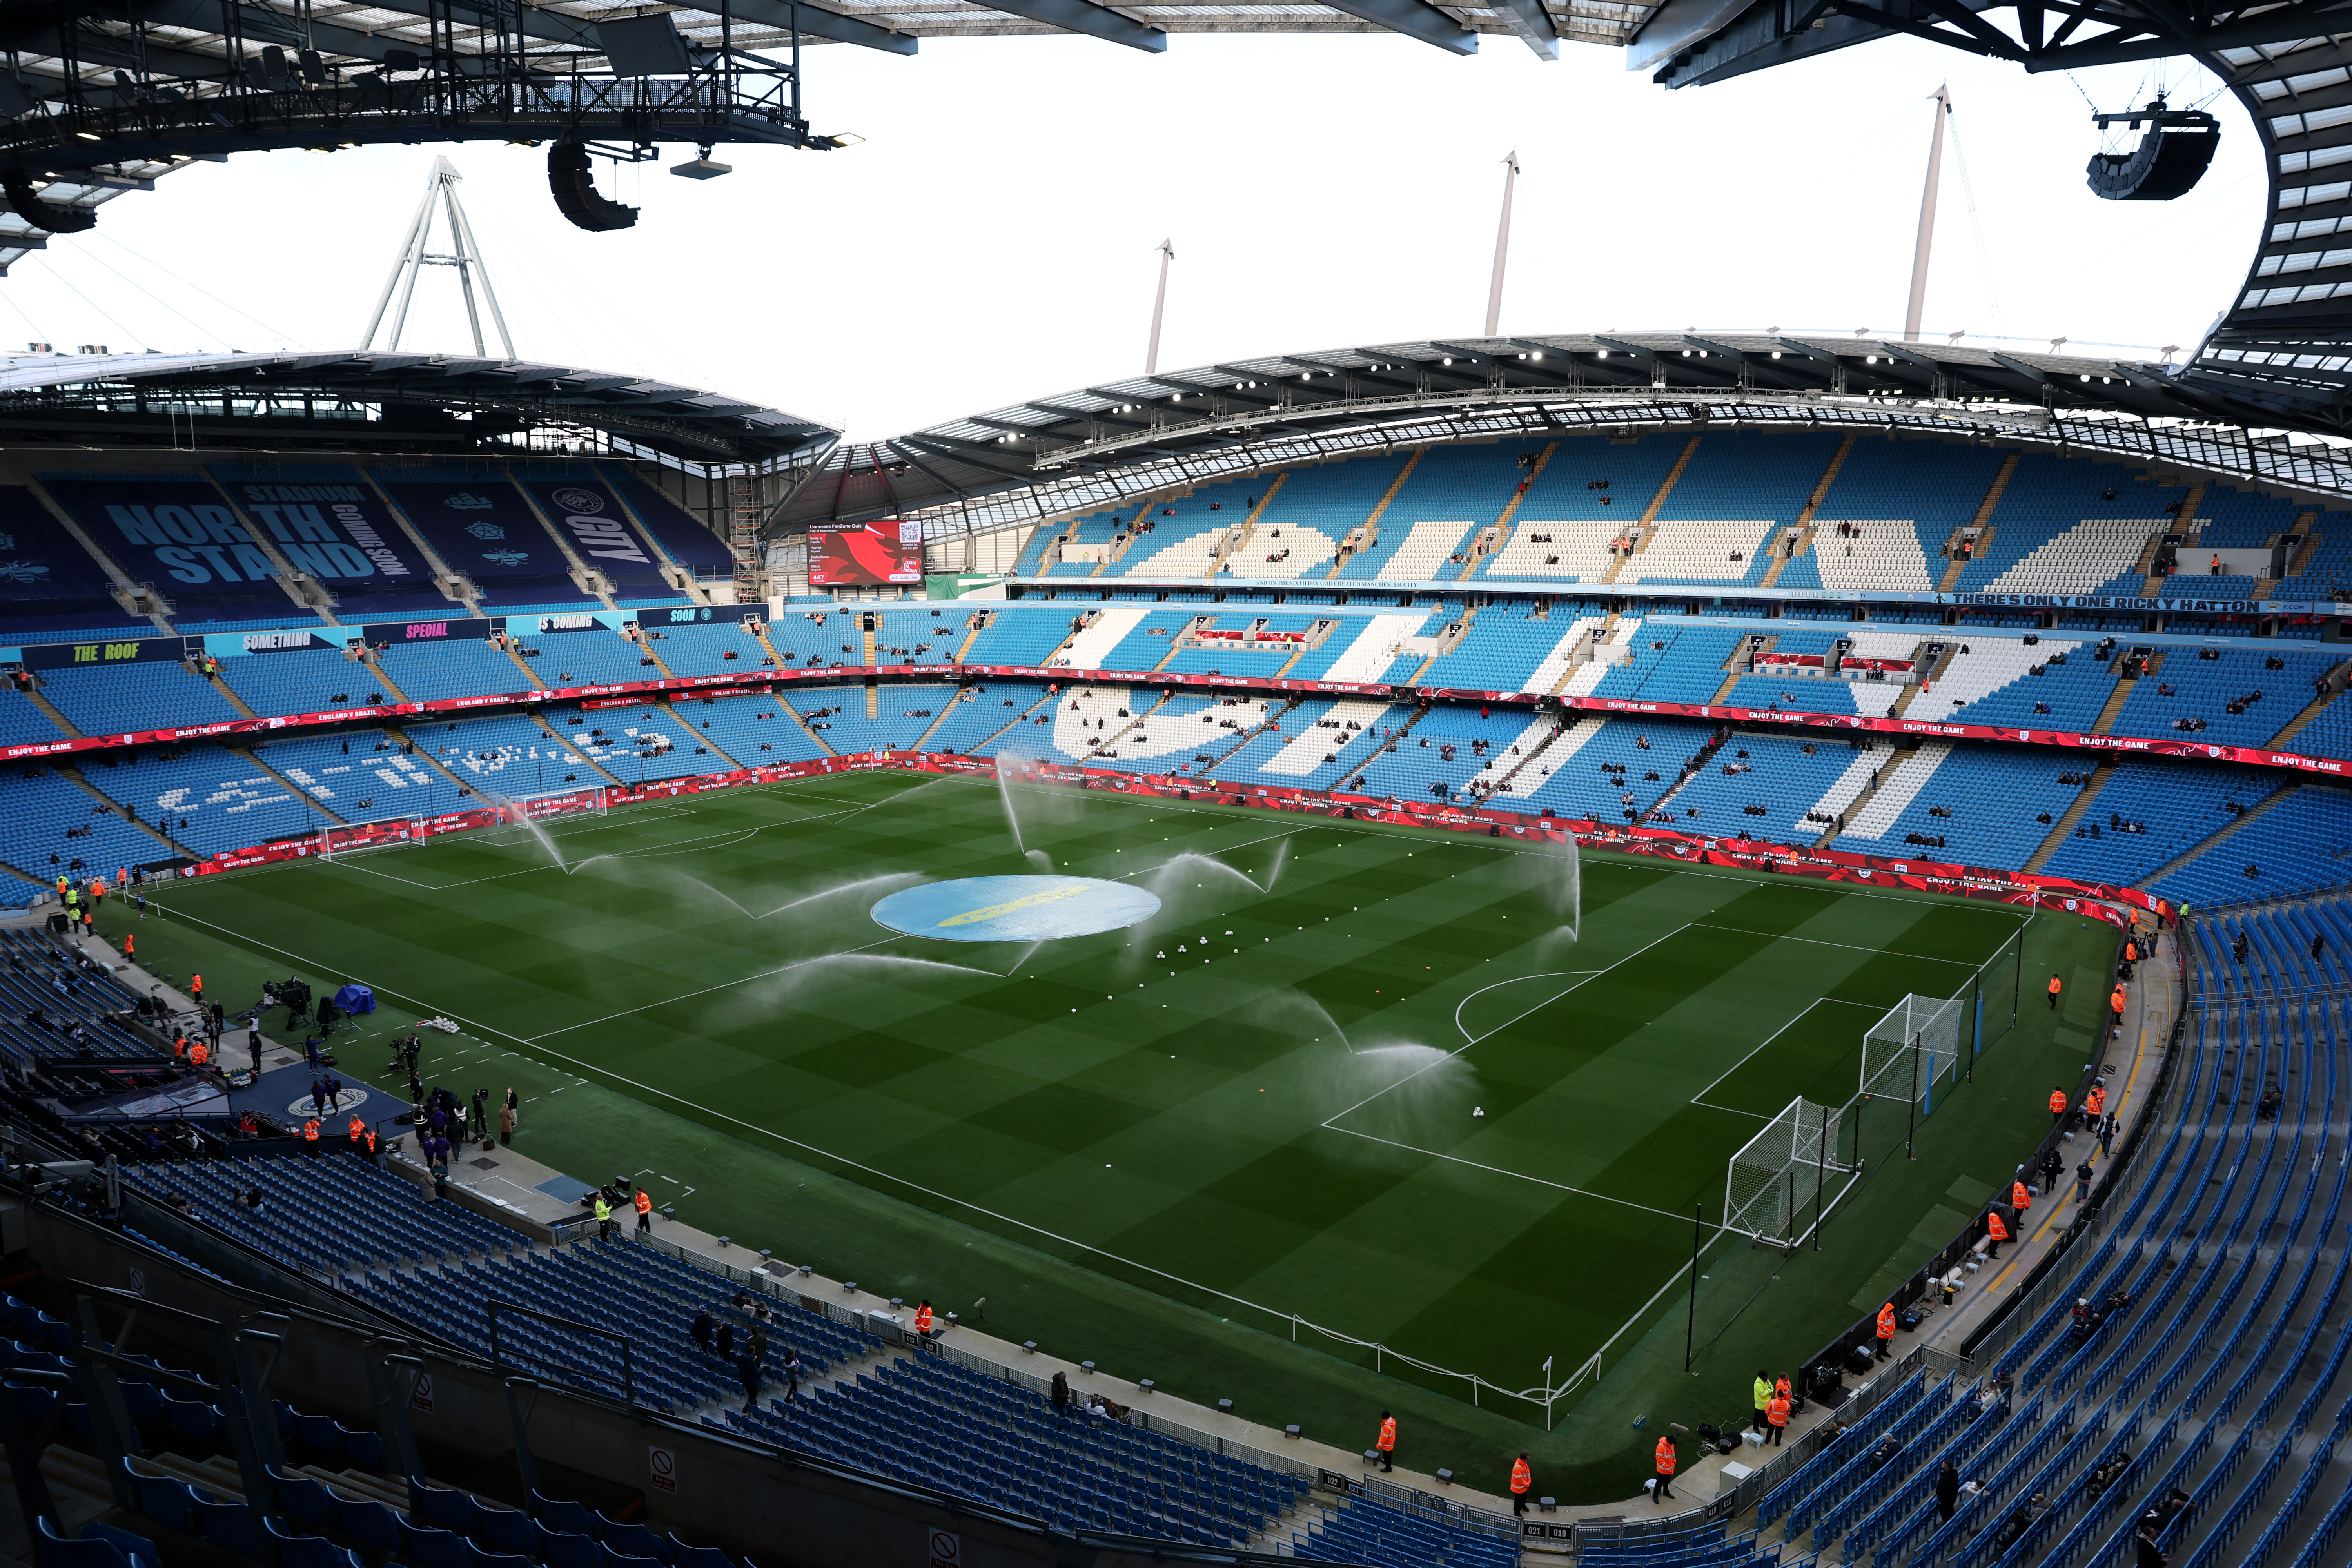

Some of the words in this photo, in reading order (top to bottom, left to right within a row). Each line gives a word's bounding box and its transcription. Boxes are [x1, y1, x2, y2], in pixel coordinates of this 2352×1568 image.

[244, 485, 366, 501] STADIUM
[578, 490, 603, 510] MANCHESTER
[331, 504, 385, 549] COMING
[365, 548, 410, 575] SOON
[565, 515, 650, 563] CITY
[2024, 594, 2070, 606] ONLY
[2074, 595, 2112, 607] ONE
[2114, 597, 2176, 610] RICKY
[2180, 599, 2259, 612] HATTON
[538, 617, 549, 630] IS
[553, 614, 592, 629] COMING
[670, 608, 695, 622] SOON
[406, 622, 448, 639] SPECIAL
[243, 632, 311, 650] SOMETHING
[74, 645, 98, 662] THE
[105, 642, 140, 660] ROOF
[2272, 756, 2299, 765] ENJOY
[2302, 759, 2316, 768] THE
[2318, 762, 2341, 771] GAME
[343, 1089, 364, 1105] NCHESTER
[1327, 1476, 1338, 1486] 022
[1708, 1506, 1717, 1517] 019
[1528, 1526, 1541, 1534] 021
[1553, 1528, 1566, 1537] 019
